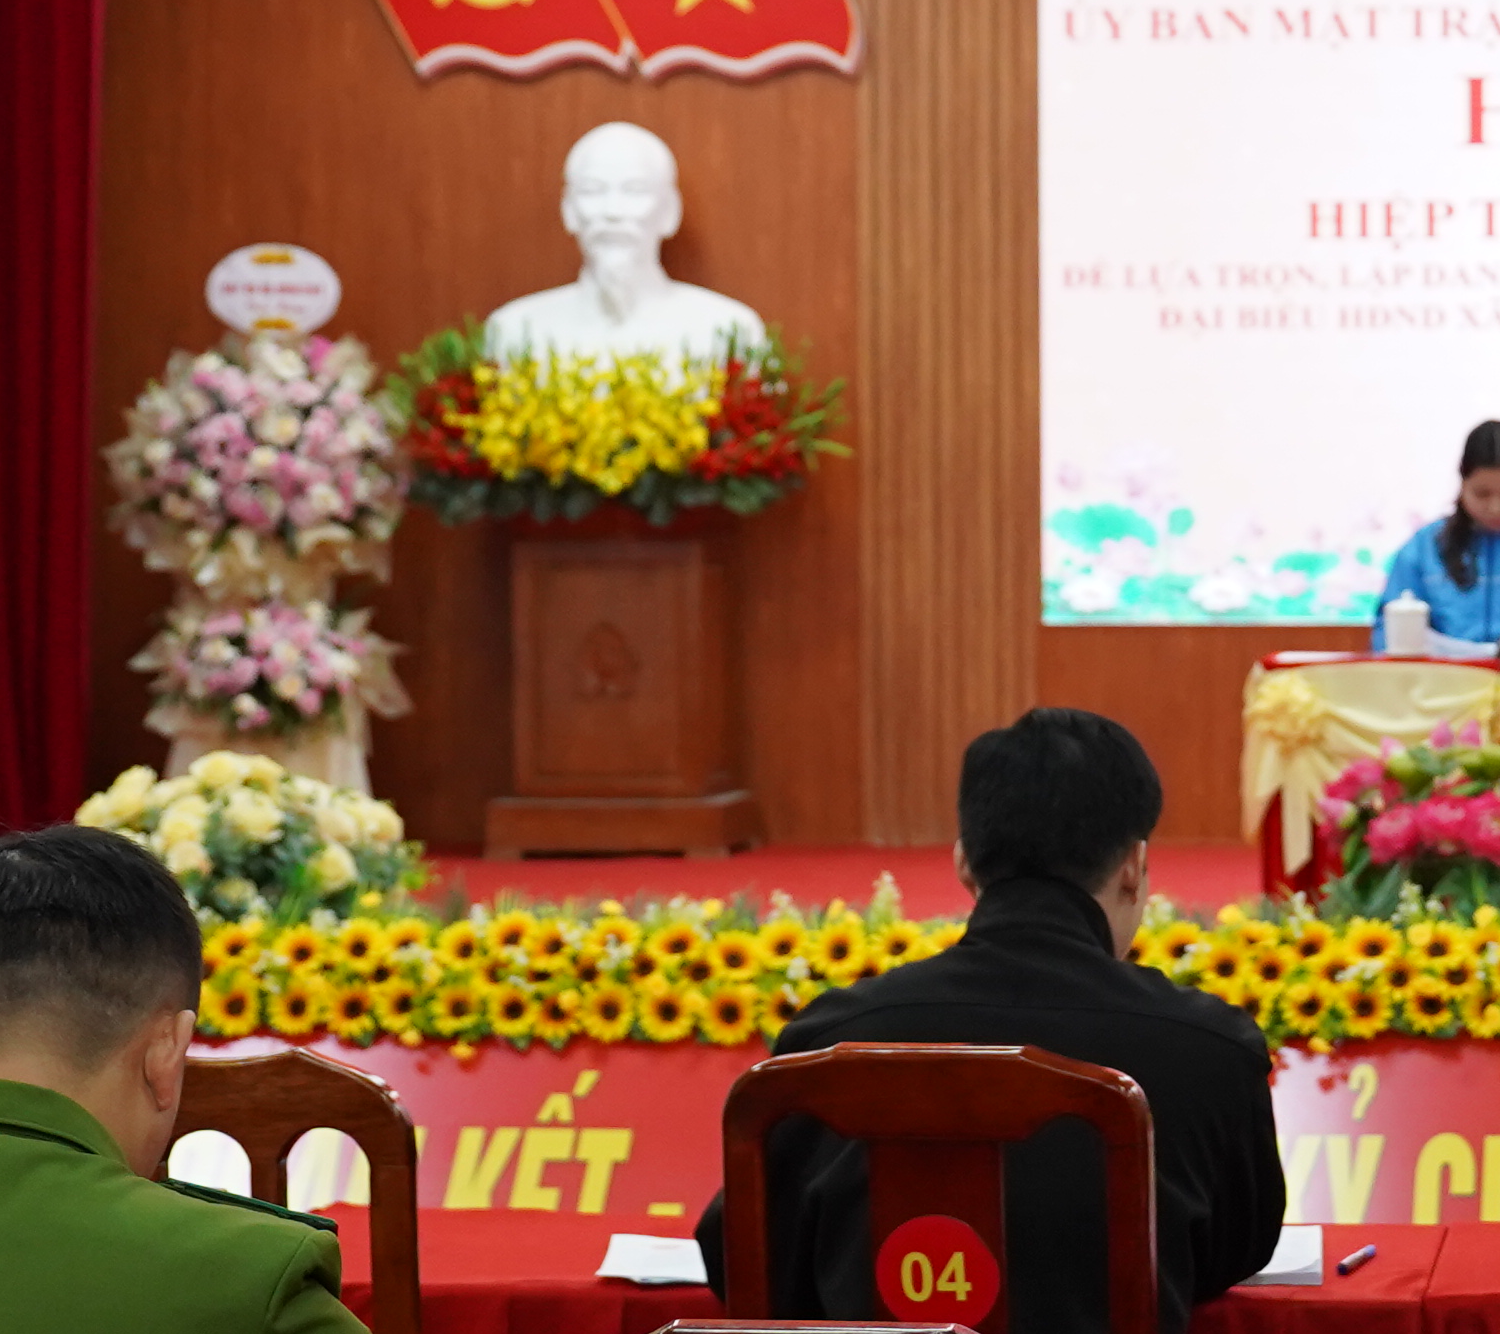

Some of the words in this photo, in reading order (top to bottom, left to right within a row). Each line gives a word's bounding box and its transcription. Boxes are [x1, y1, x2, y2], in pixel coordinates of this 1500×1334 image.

[1148, 8, 1253, 40] BAN
[1273, 3, 1384, 50] MẶT
[1305, 193, 1457, 250] HIỆP
[900, 1250, 973, 1302] 04
